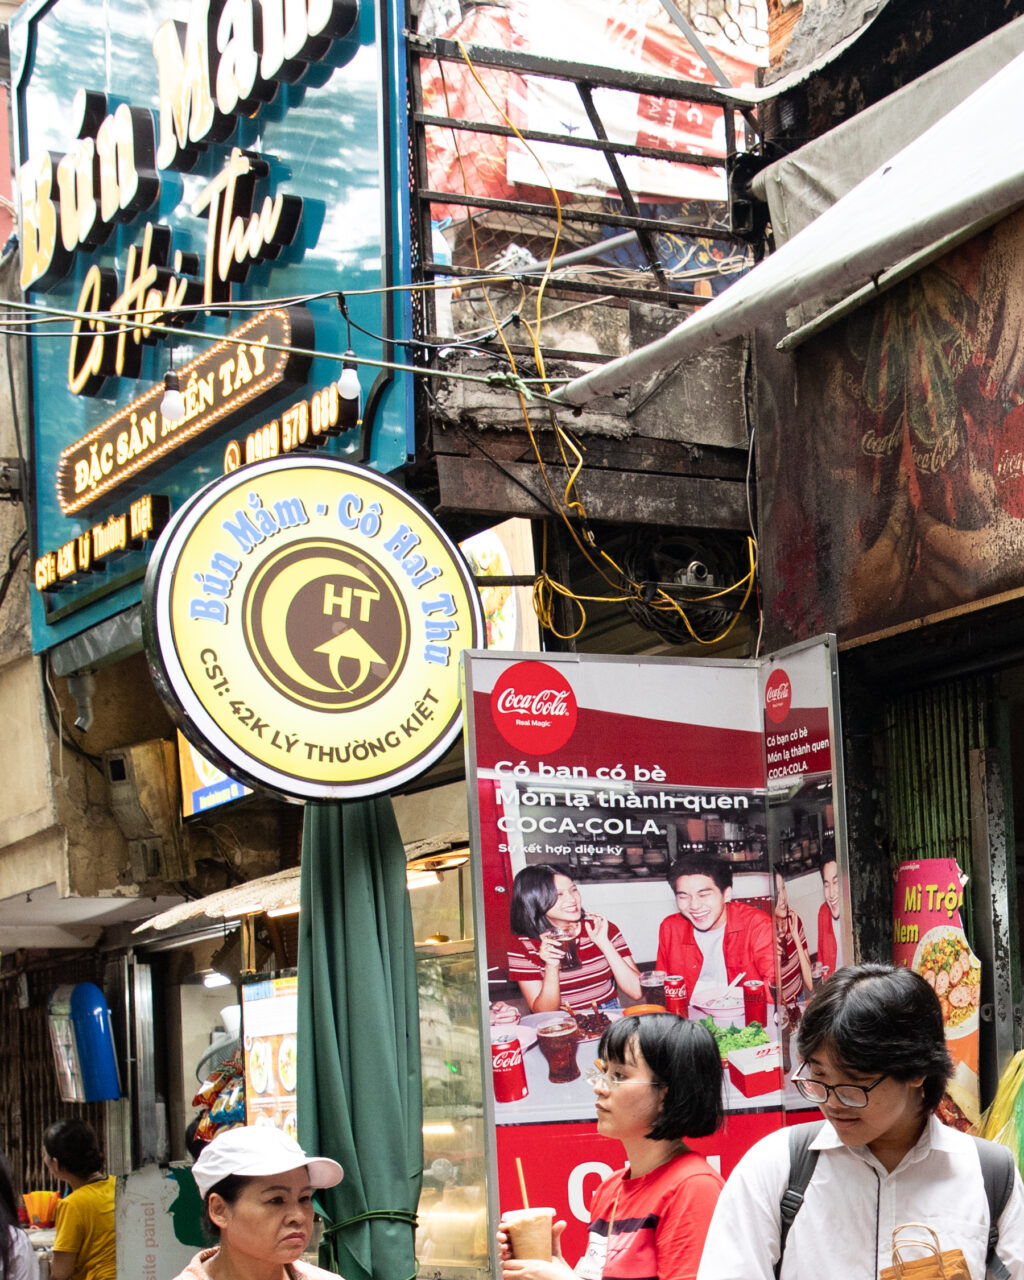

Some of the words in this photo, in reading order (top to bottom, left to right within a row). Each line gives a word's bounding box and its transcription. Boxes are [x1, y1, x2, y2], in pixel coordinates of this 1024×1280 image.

[190, 147, 283, 316] Thu
[74, 442, 114, 494] ĐẶC
[116, 411, 157, 465] SẢN
[219, 335, 269, 397] TÂY
[282, 399, 309, 453] 578
[311, 381, 339, 436] 088
[56, 539, 76, 580] 42K
[189, 551, 242, 625] Bún
[337, 493, 383, 537] Cô
[383, 523, 443, 588] Hai
[421, 592, 458, 666] Thu
[322, 583, 381, 623] HT
[200, 648, 231, 697] CS1:
[229, 699, 270, 739] 42K
[270, 730, 300, 754] LÝ
[304, 731, 401, 764] THƯỜNG
[399, 688, 440, 738] KIỆT
[497, 687, 570, 717] Coca-Cola
[531, 719, 552, 728] Magic
[766, 736, 776, 747] Có
[777, 733, 790, 746] bạn
[789, 729, 799, 741] có
[799, 726, 808, 738] bè
[767, 752, 783, 764] Món
[783, 749, 791, 762] lạ
[791, 743, 811, 759] thành
[812, 739, 830, 753] quen
[494, 760, 530, 777] Có
[538, 761, 588, 782] bạn
[596, 763, 626, 781] có
[634, 764, 667, 782] bè
[768, 761, 808, 780] COCA-COLA
[495, 788, 556, 807] Món
[564, 790, 590, 811] lạ
[596, 790, 677, 809] thành
[683, 793, 749, 815] quen
[497, 816, 660, 835] COCA-COLA
[521, 843, 542, 854] kết
[546, 844, 573, 856] hợp
[575, 843, 604, 856] diệu
[607, 844, 623, 856] kỳ
[904, 883, 922, 912] Mì
[894, 918, 919, 944] Nem
[142, 1202, 158, 1249] panel
